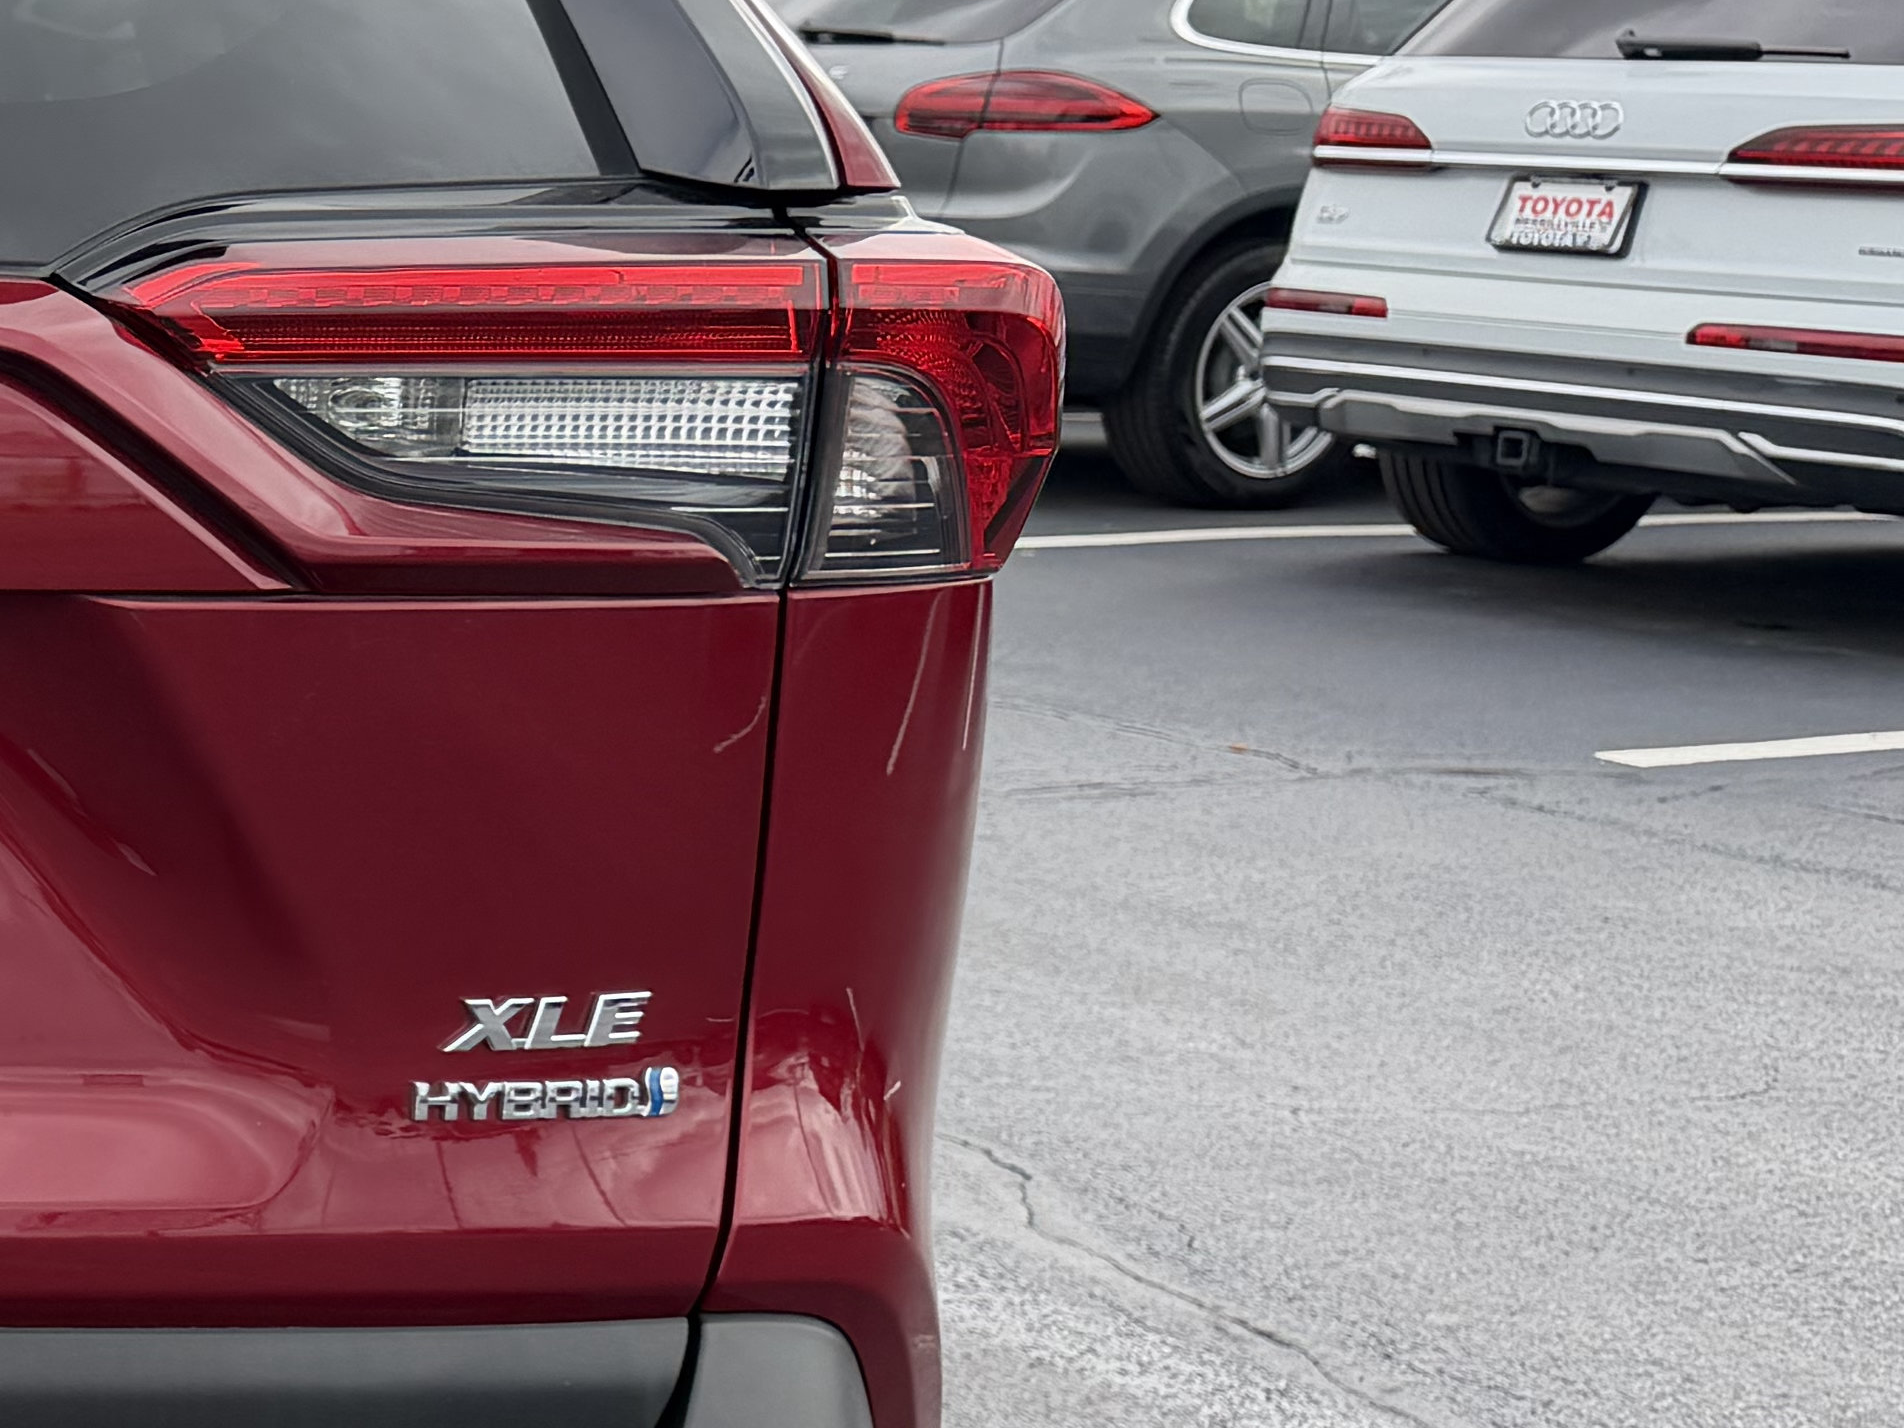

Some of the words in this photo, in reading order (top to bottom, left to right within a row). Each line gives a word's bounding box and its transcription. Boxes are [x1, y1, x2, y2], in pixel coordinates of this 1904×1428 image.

[1517, 194, 1615, 220] TOYOTA
[438, 990, 653, 1052] XLE
[410, 1078, 642, 1122] HYBRID
